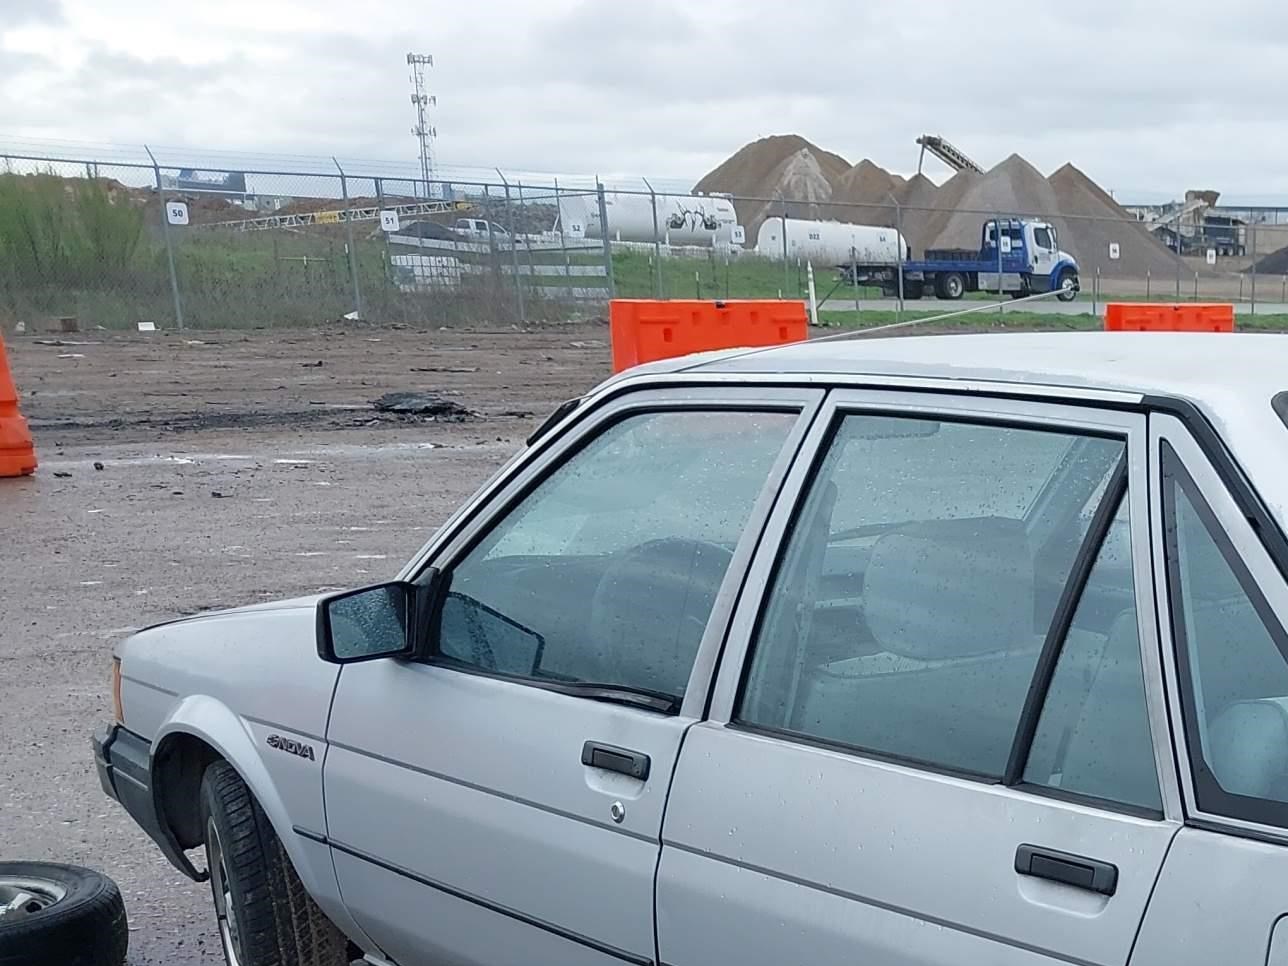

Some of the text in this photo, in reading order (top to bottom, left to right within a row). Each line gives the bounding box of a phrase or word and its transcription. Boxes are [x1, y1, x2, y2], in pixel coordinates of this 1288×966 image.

[172, 208, 184, 218] 50
[385, 217, 394, 225] 51
[277, 736, 316, 762] NOVA
